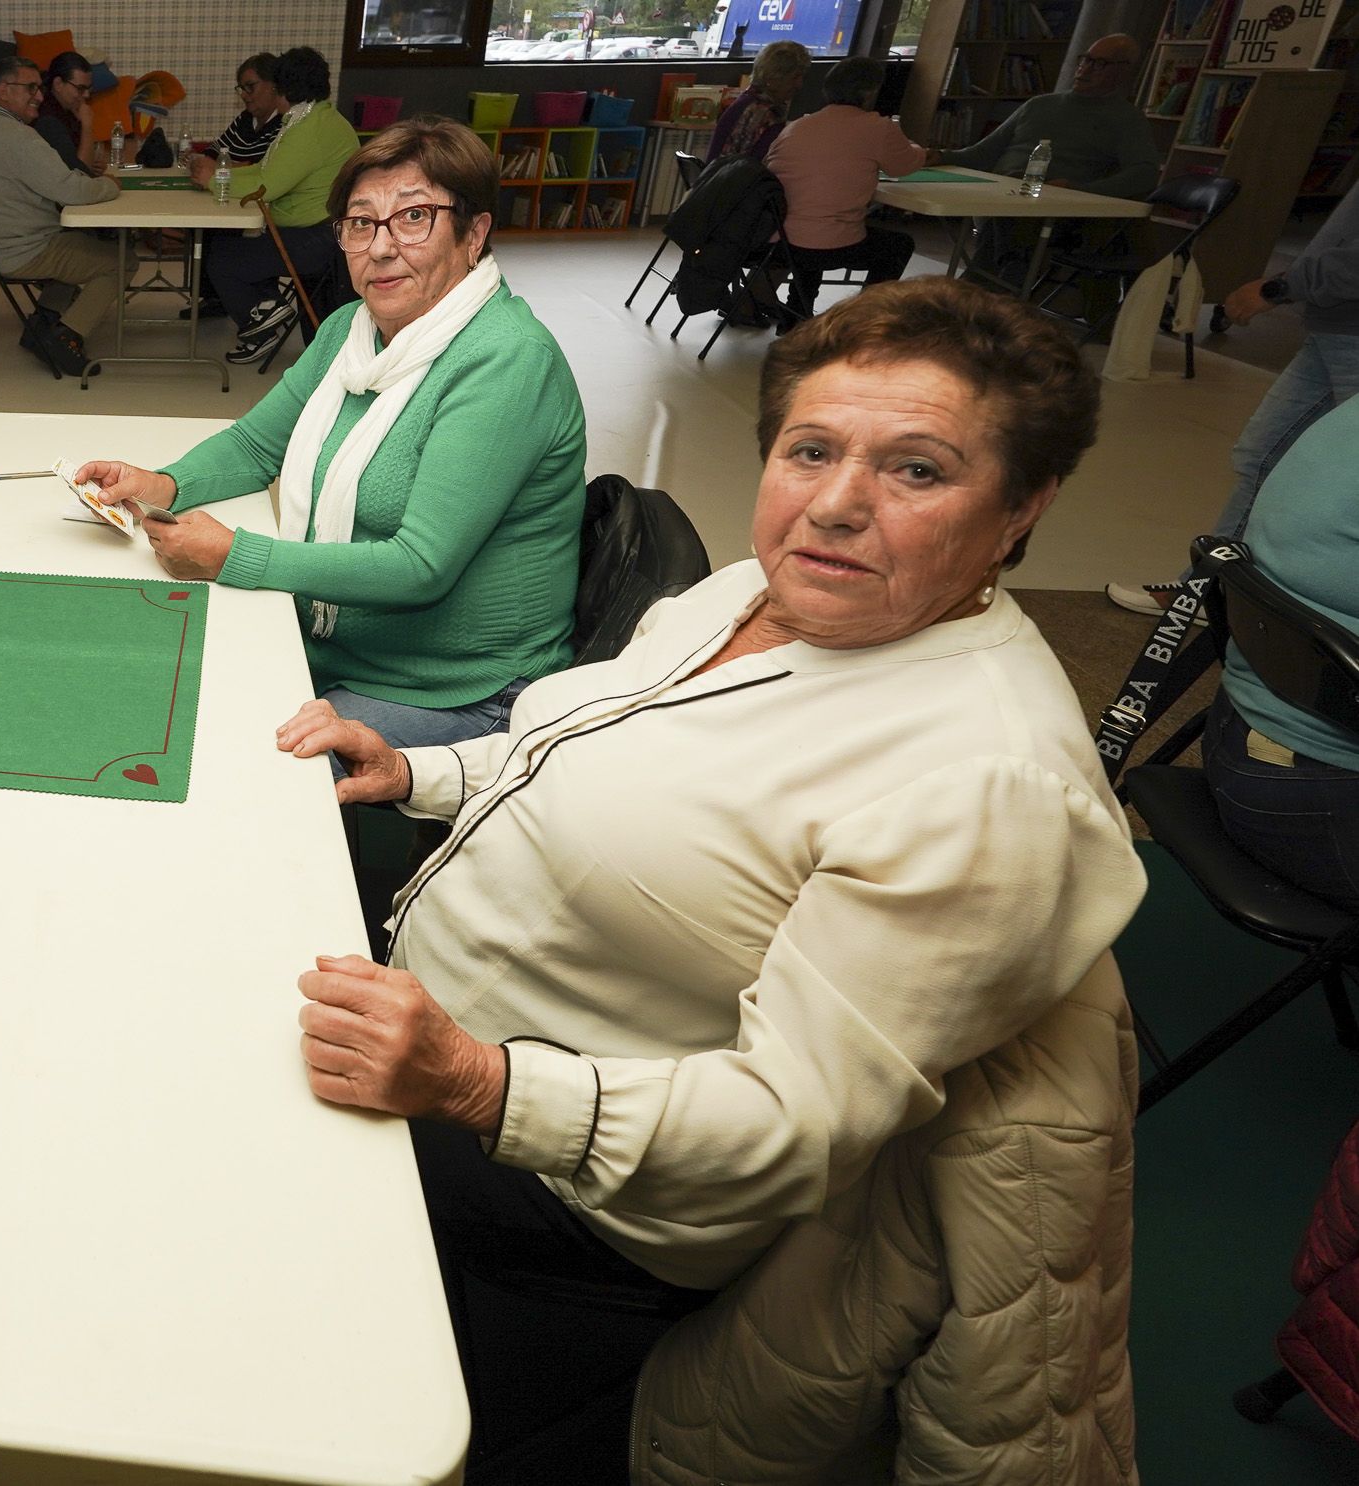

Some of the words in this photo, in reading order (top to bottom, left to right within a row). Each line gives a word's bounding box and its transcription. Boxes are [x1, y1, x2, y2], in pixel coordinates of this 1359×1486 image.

[1239, 41, 1279, 62] TOS
[1144, 576, 1211, 665] BIMBA
[1095, 680, 1159, 761] BIMBA
